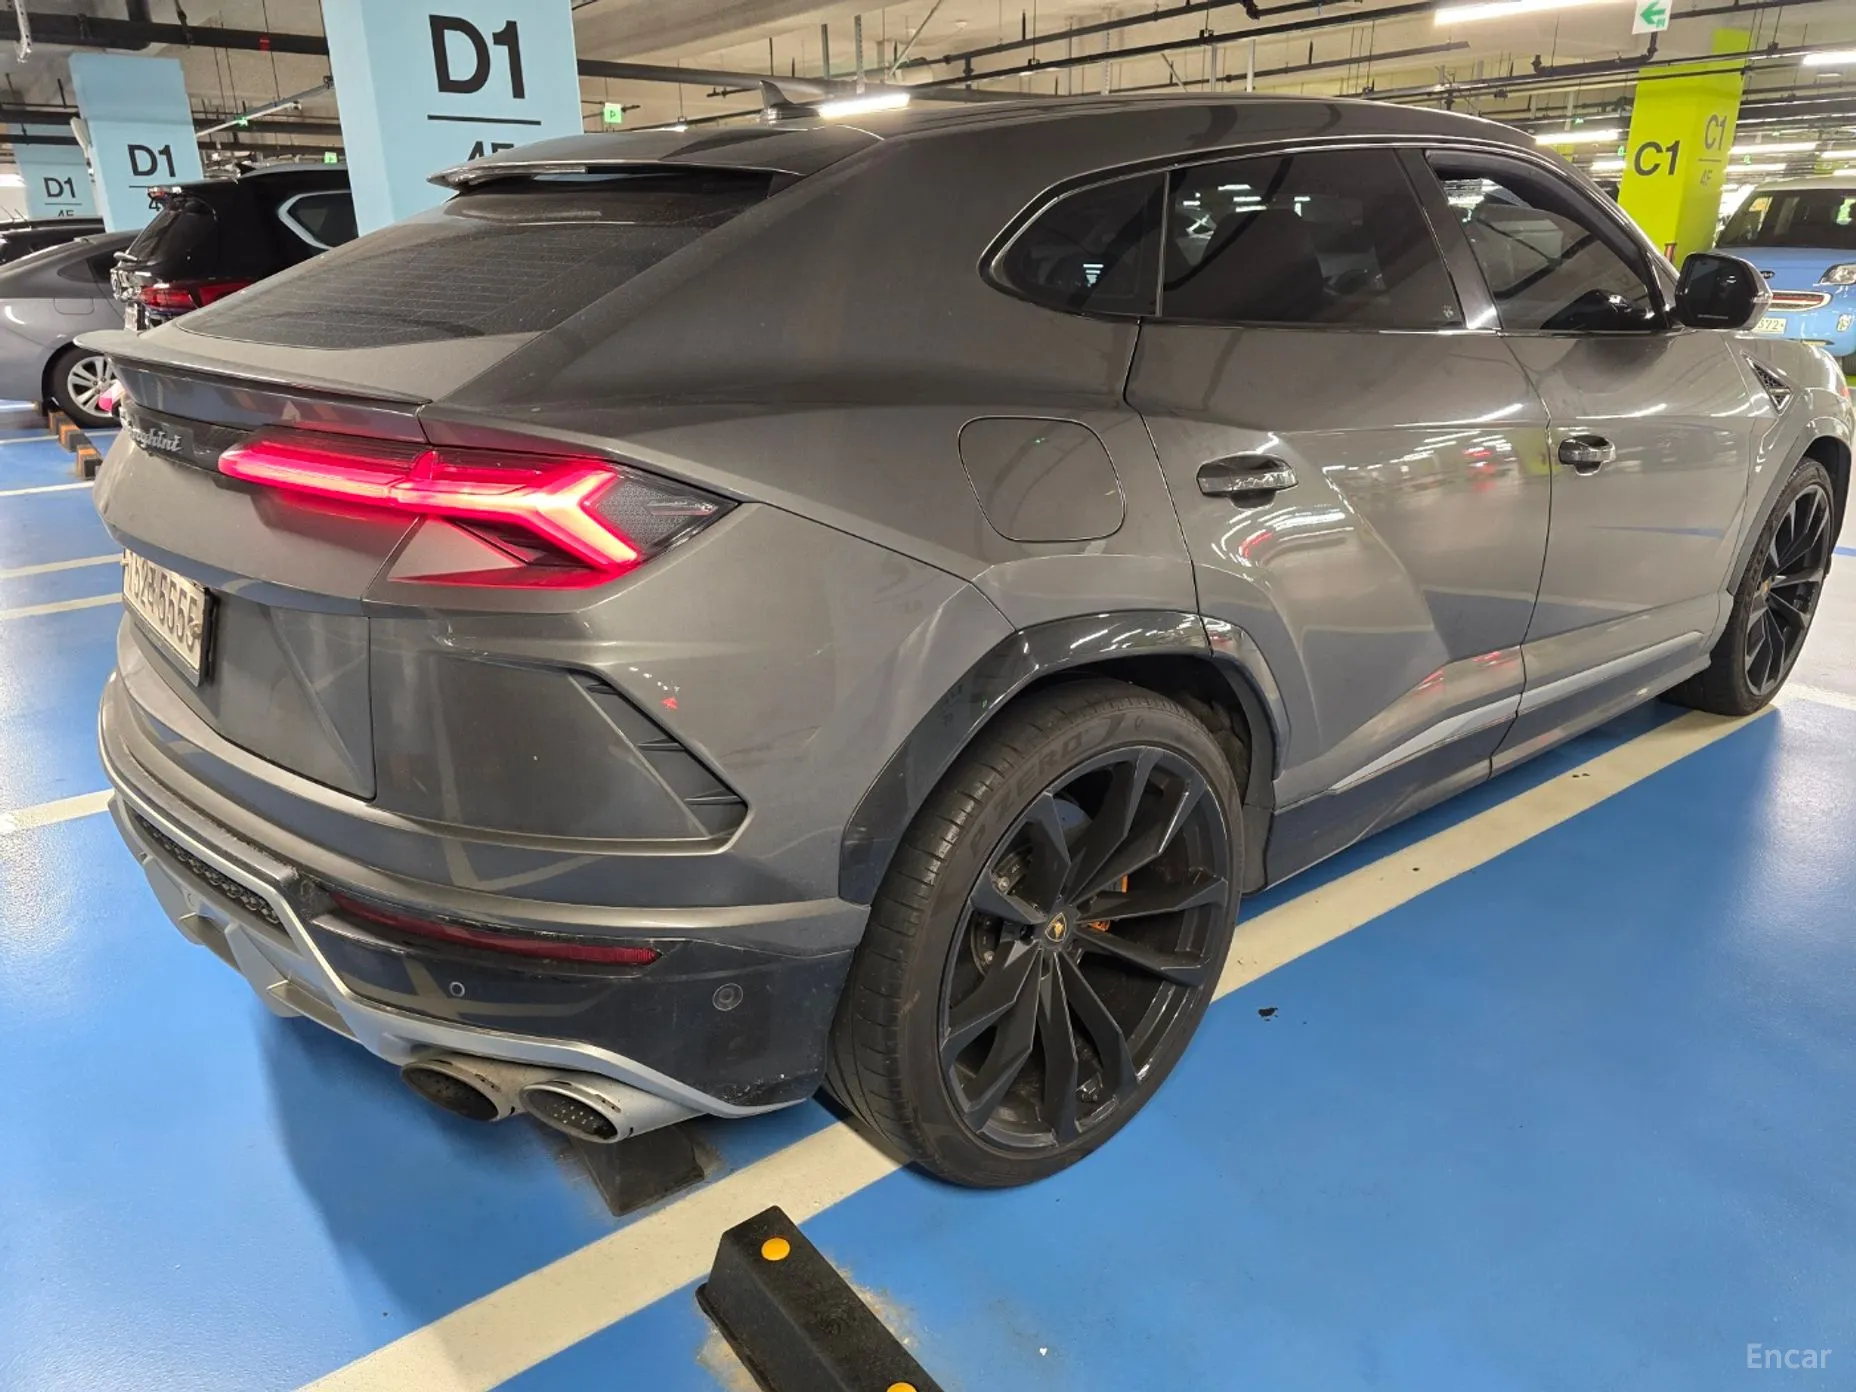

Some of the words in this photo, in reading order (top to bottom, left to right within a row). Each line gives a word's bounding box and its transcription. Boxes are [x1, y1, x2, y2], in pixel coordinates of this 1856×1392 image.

[428, 14, 526, 100] D1
[1704, 113, 1728, 151] C1
[127, 144, 176, 178] D1
[1634, 140, 1680, 176] C1
[43, 176, 77, 199] D1
